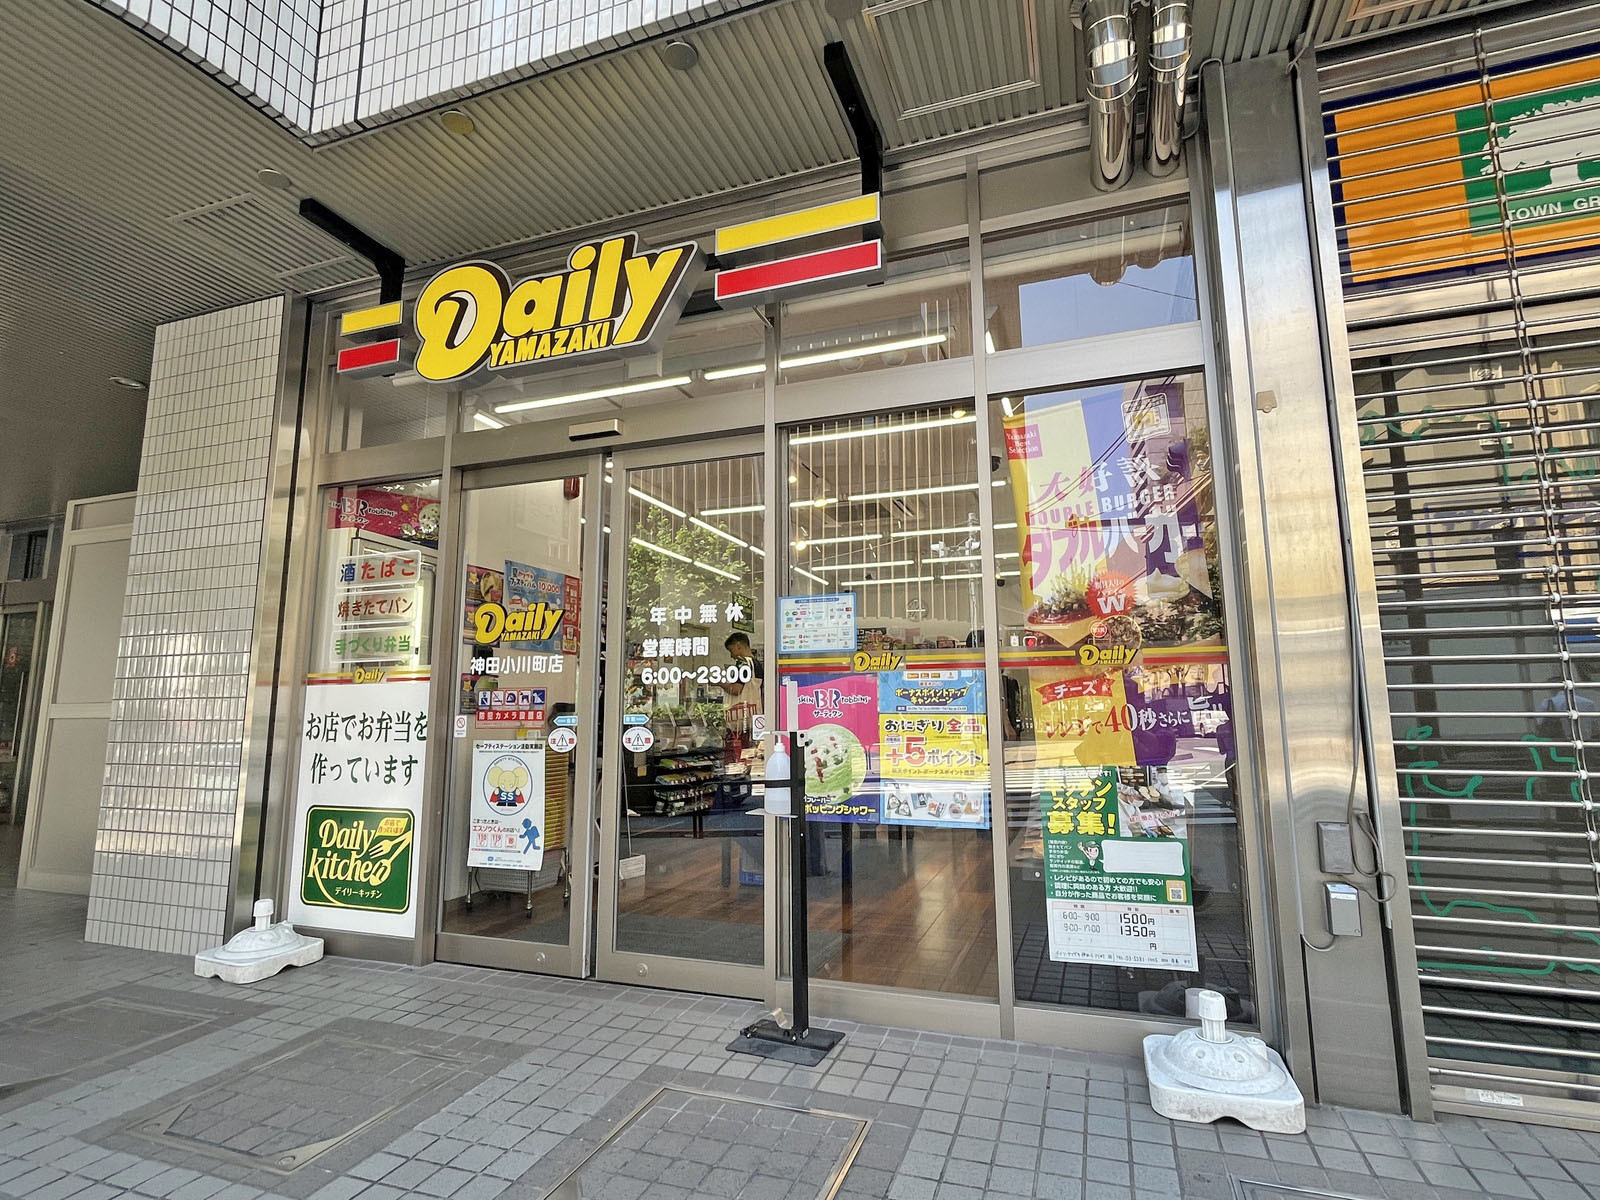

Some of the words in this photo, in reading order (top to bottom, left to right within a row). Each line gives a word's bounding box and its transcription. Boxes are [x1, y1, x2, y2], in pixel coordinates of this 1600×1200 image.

[1507, 201, 1562, 220] TOWN
[415, 237, 690, 380] Daily
[489, 318, 611, 368] YAMAZAKI
[1101, 483, 1177, 512] BURGER
[340, 563, 356, 582] 酒
[360, 558, 415, 580] たばこ
[337, 597, 413, 618] 焼きたてパン
[650, 602, 744, 626] 年中無休
[1097, 593, 1126, 614] W
[475, 602, 565, 644] Daily
[335, 635, 411, 655] 手づくり弁当
[500, 631, 540, 642] YAMAZAKI
[641, 636, 709, 658] 営業時間
[470, 654, 564, 675] 神田小川町店
[854, 652, 902, 671] Daily
[1079, 644, 1138, 666] Daily
[354, 667, 385, 684] Daily
[814, 688, 841, 708] BR
[1054, 680, 1098, 697] チーズ
[911, 696, 953, 705] キャンペーン
[813, 710, 843, 718] サーティワン
[305, 710, 428, 743] お店でお弁当を
[310, 752, 418, 786] 作っています
[500, 792, 514, 800] SS
[1052, 797, 1107, 811] スタッフ
[319, 819, 376, 858] Daily
[307, 848, 391, 886] kitchen
[334, 886, 382, 899] デイリーキッチン
[1149, 942, 1157, 950] 円
